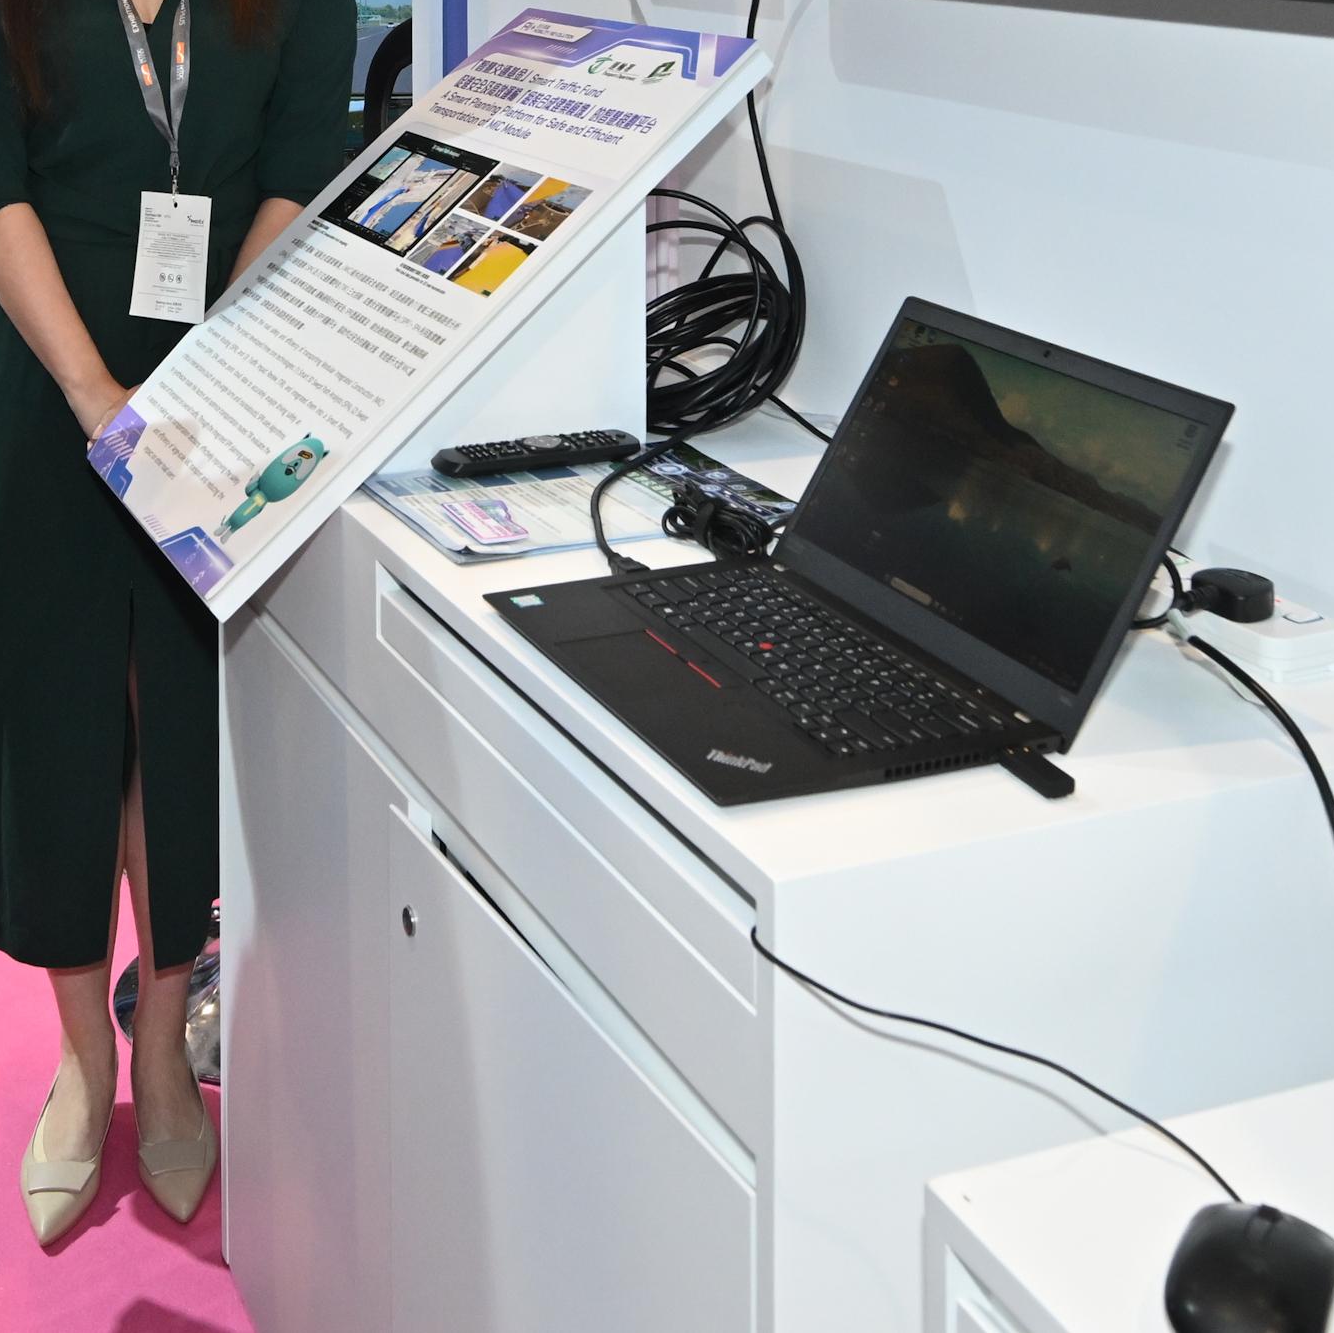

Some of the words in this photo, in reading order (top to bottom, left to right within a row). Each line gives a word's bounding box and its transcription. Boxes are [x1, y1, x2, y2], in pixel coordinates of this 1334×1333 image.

[532, 73, 554, 88] Smart
[554, 77, 581, 94] Traffic
[582, 84, 607, 99] Fund
[429, 103, 486, 127] Transportation
[502, 123, 533, 140] Module
[450, 92, 470, 107] Smart
[470, 97, 503, 116] Planning
[500, 105, 536, 123] Platform
[536, 112, 547, 125] for
[546, 116, 566, 131] Safe
[565, 121, 583, 135] and
[582, 126, 625, 146] Efficient
[706, 748, 773, 774] ThinkPad
